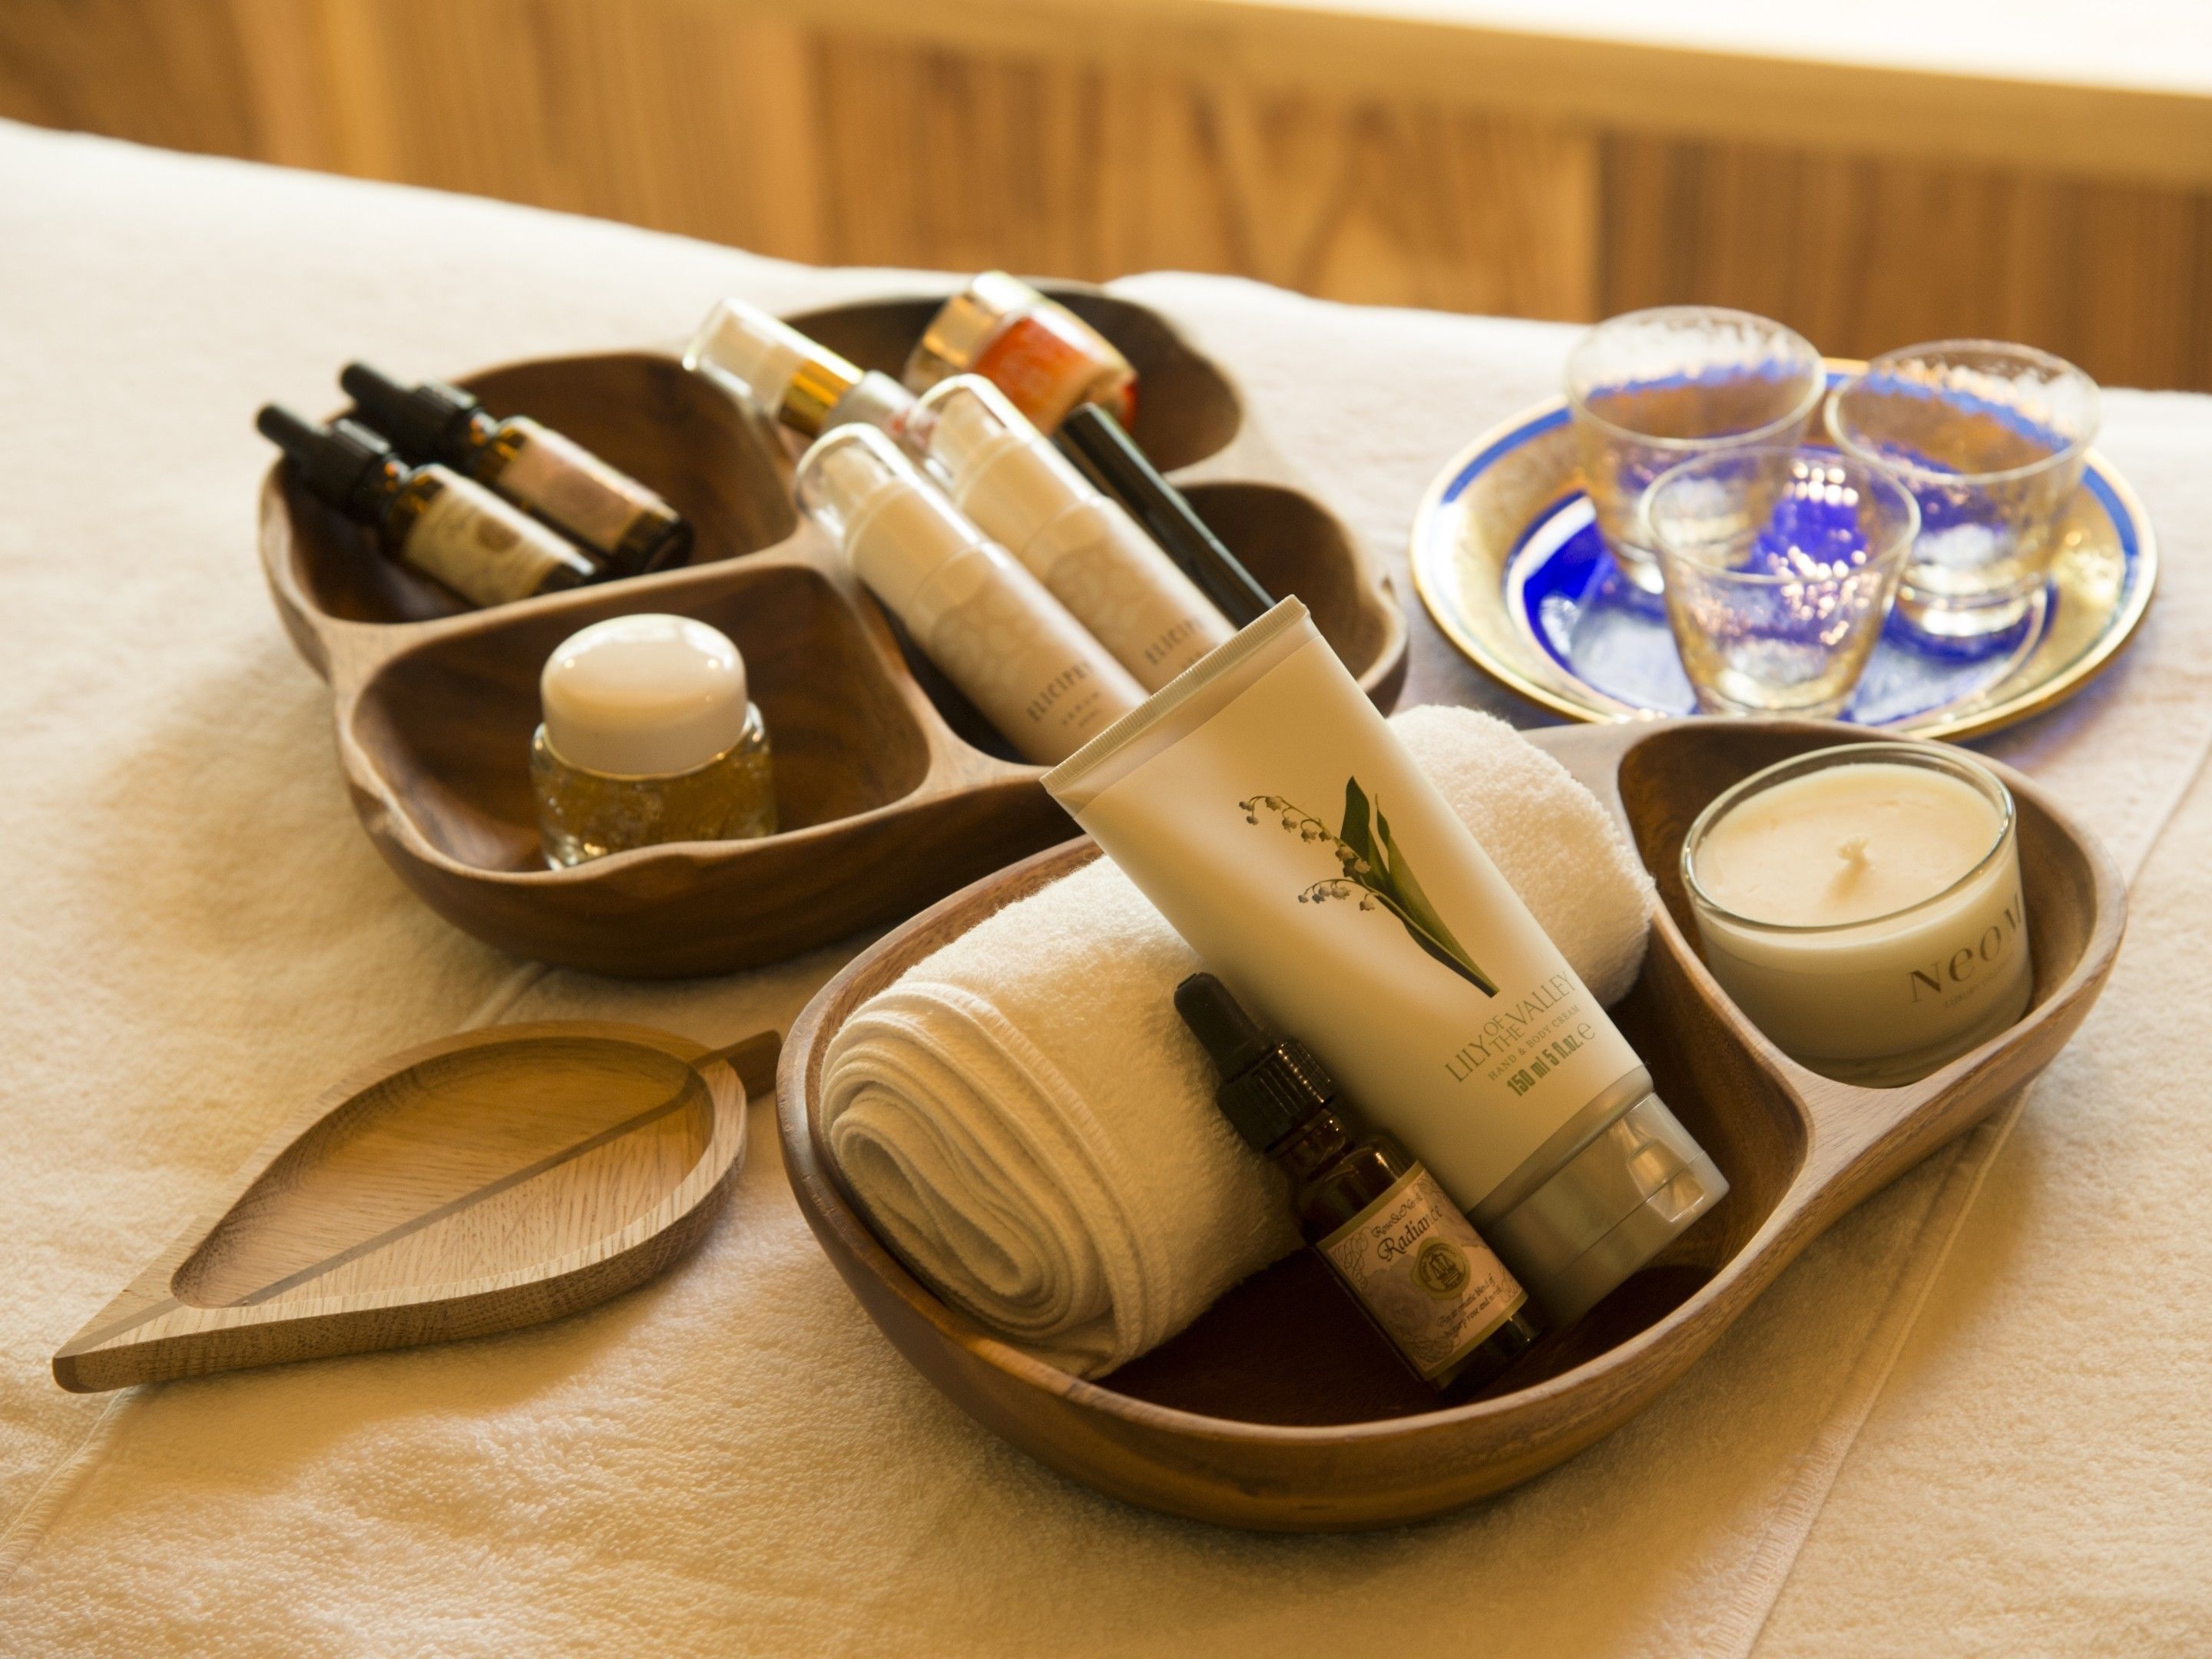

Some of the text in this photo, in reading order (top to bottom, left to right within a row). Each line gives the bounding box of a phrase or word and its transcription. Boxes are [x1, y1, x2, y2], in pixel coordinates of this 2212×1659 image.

[1444, 971, 1577, 1083] LILY OF THE VALLEY
[1487, 1004, 1581, 1081] HAND & BODY CREAM
[1507, 1068, 1537, 1097] 150
[1530, 1055, 1551, 1079] ml
[1541, 1048, 1560, 1067] 5
[1377, 1204, 1442, 1262] Radiance
